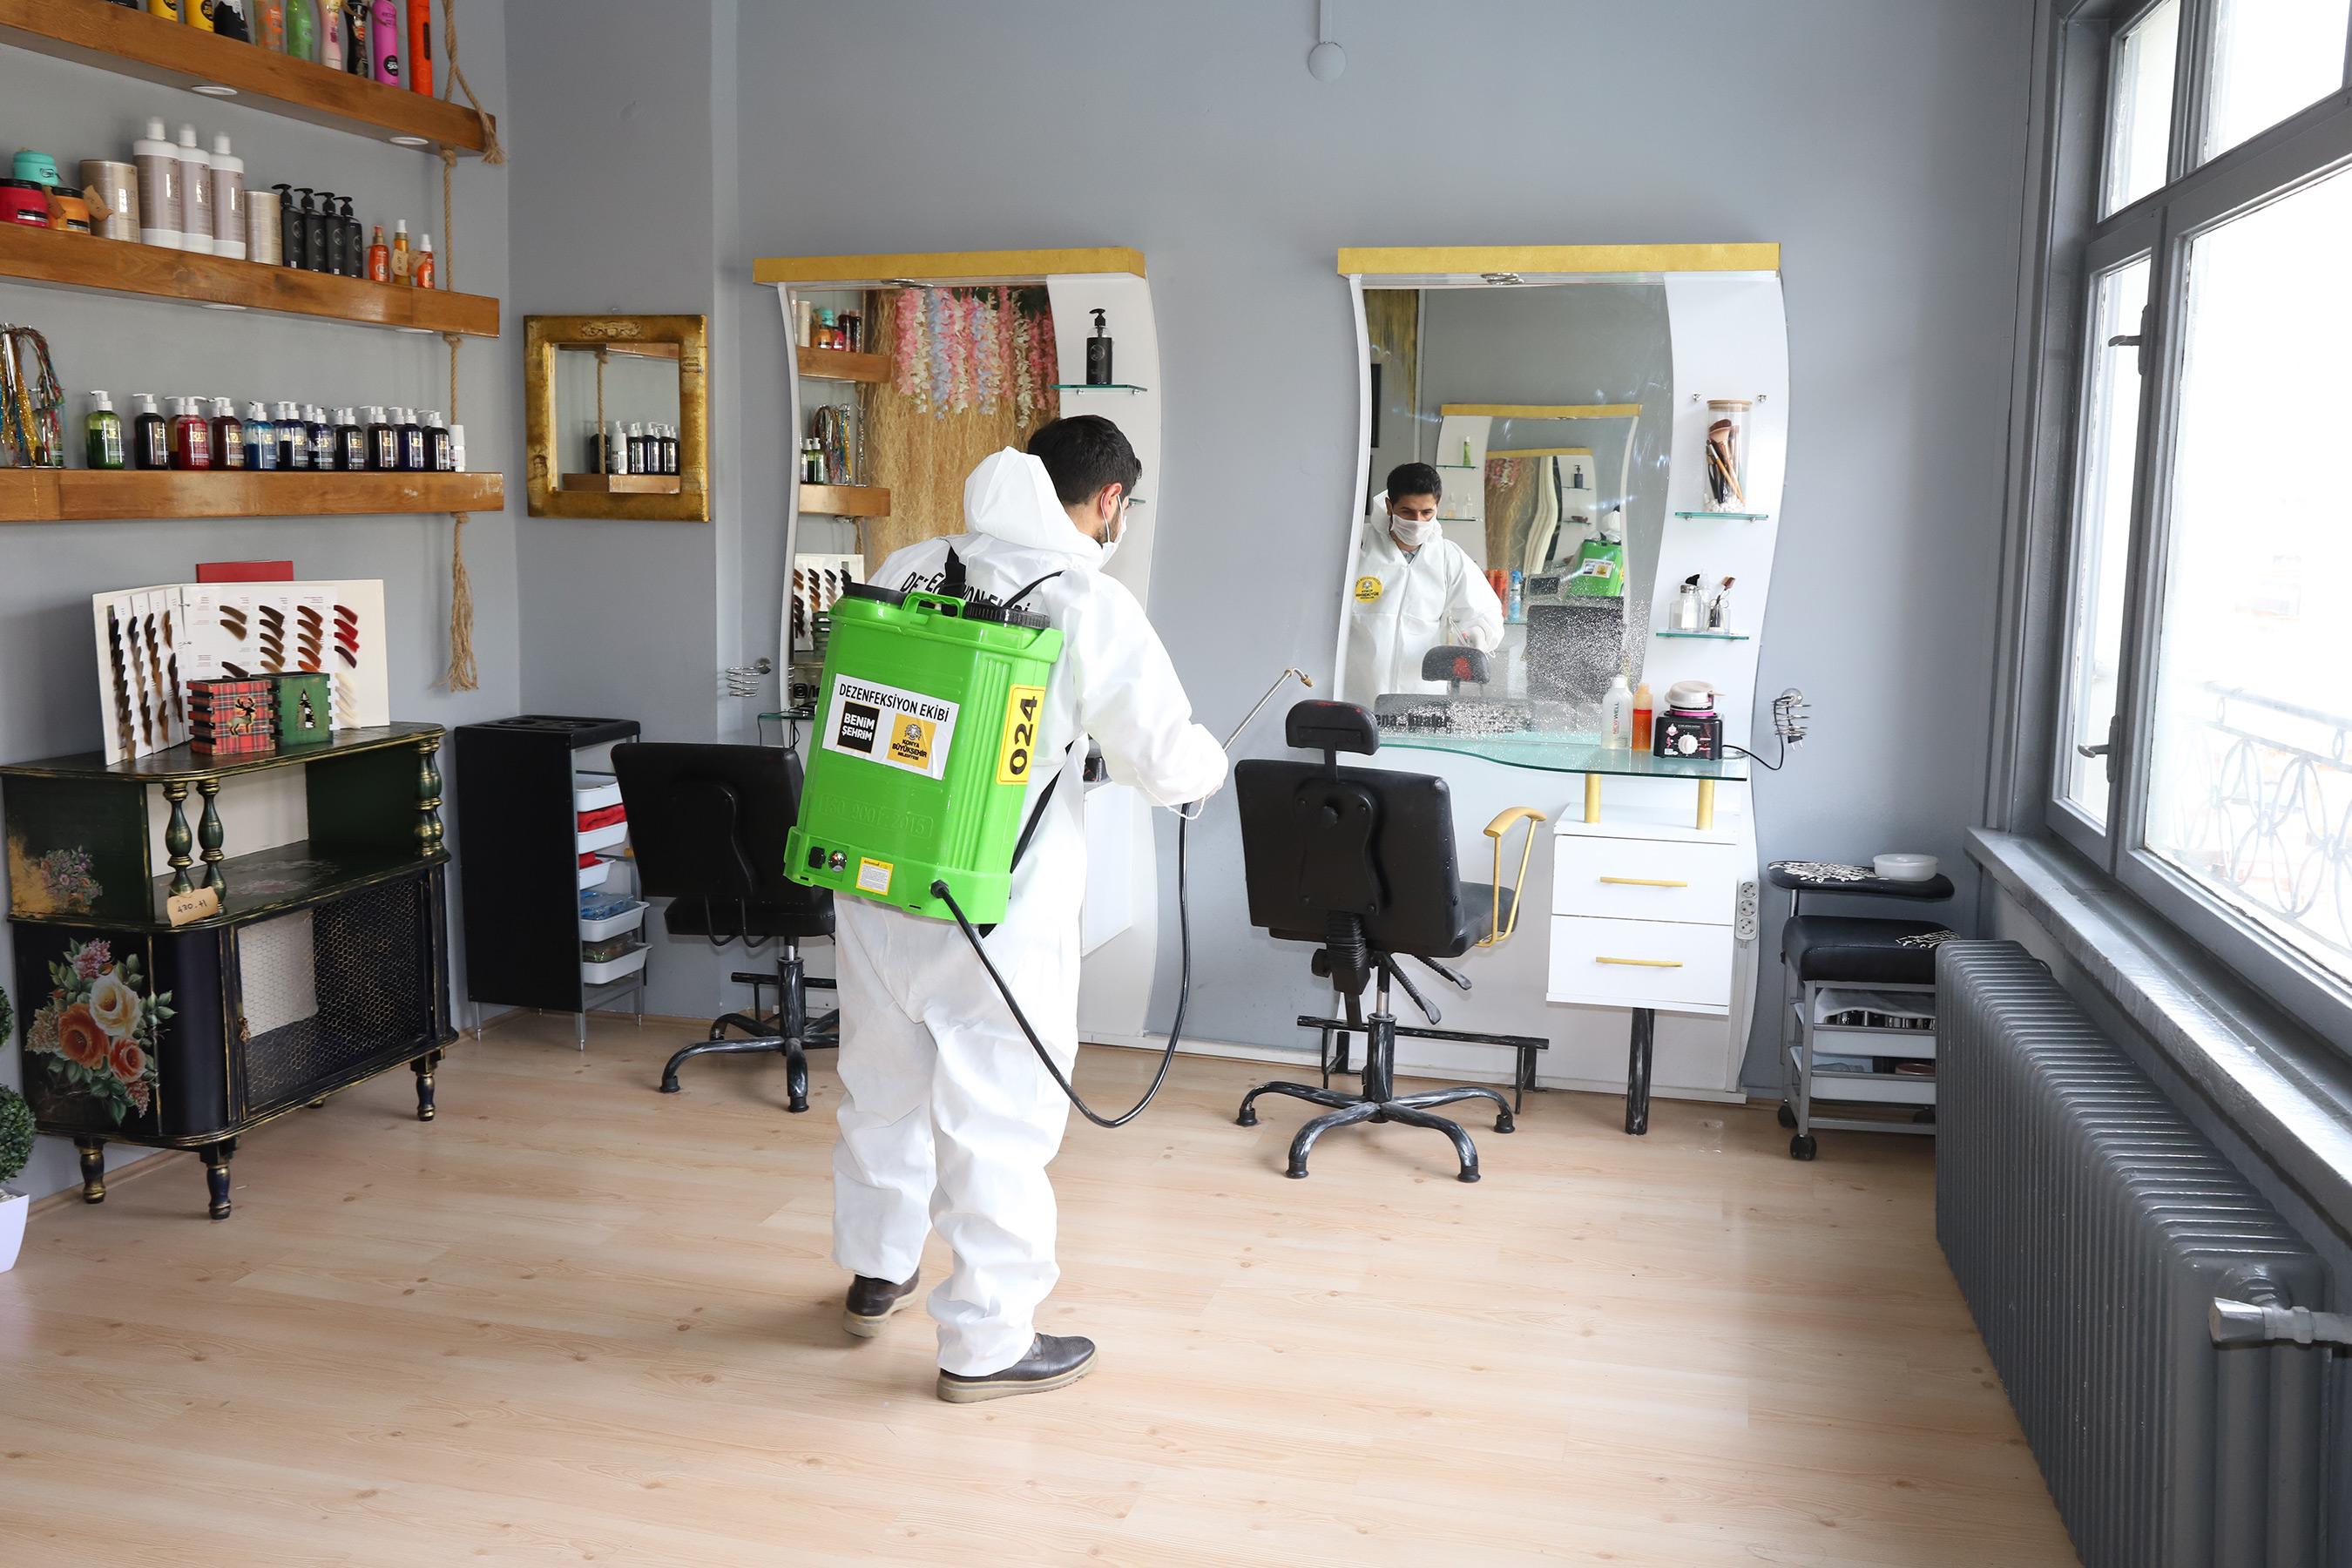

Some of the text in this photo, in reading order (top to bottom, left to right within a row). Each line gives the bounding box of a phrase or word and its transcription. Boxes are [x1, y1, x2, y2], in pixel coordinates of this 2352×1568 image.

[839, 683, 917, 714] DEZENFEKSİYON
[919, 703, 950, 722] EKİBİ
[841, 725, 873, 741] ŞEHRİM
[1010, 696, 1037, 775] 024
[892, 743, 927, 758] BÜYÜKŞEHİR
[902, 740, 920, 748] KONYA
